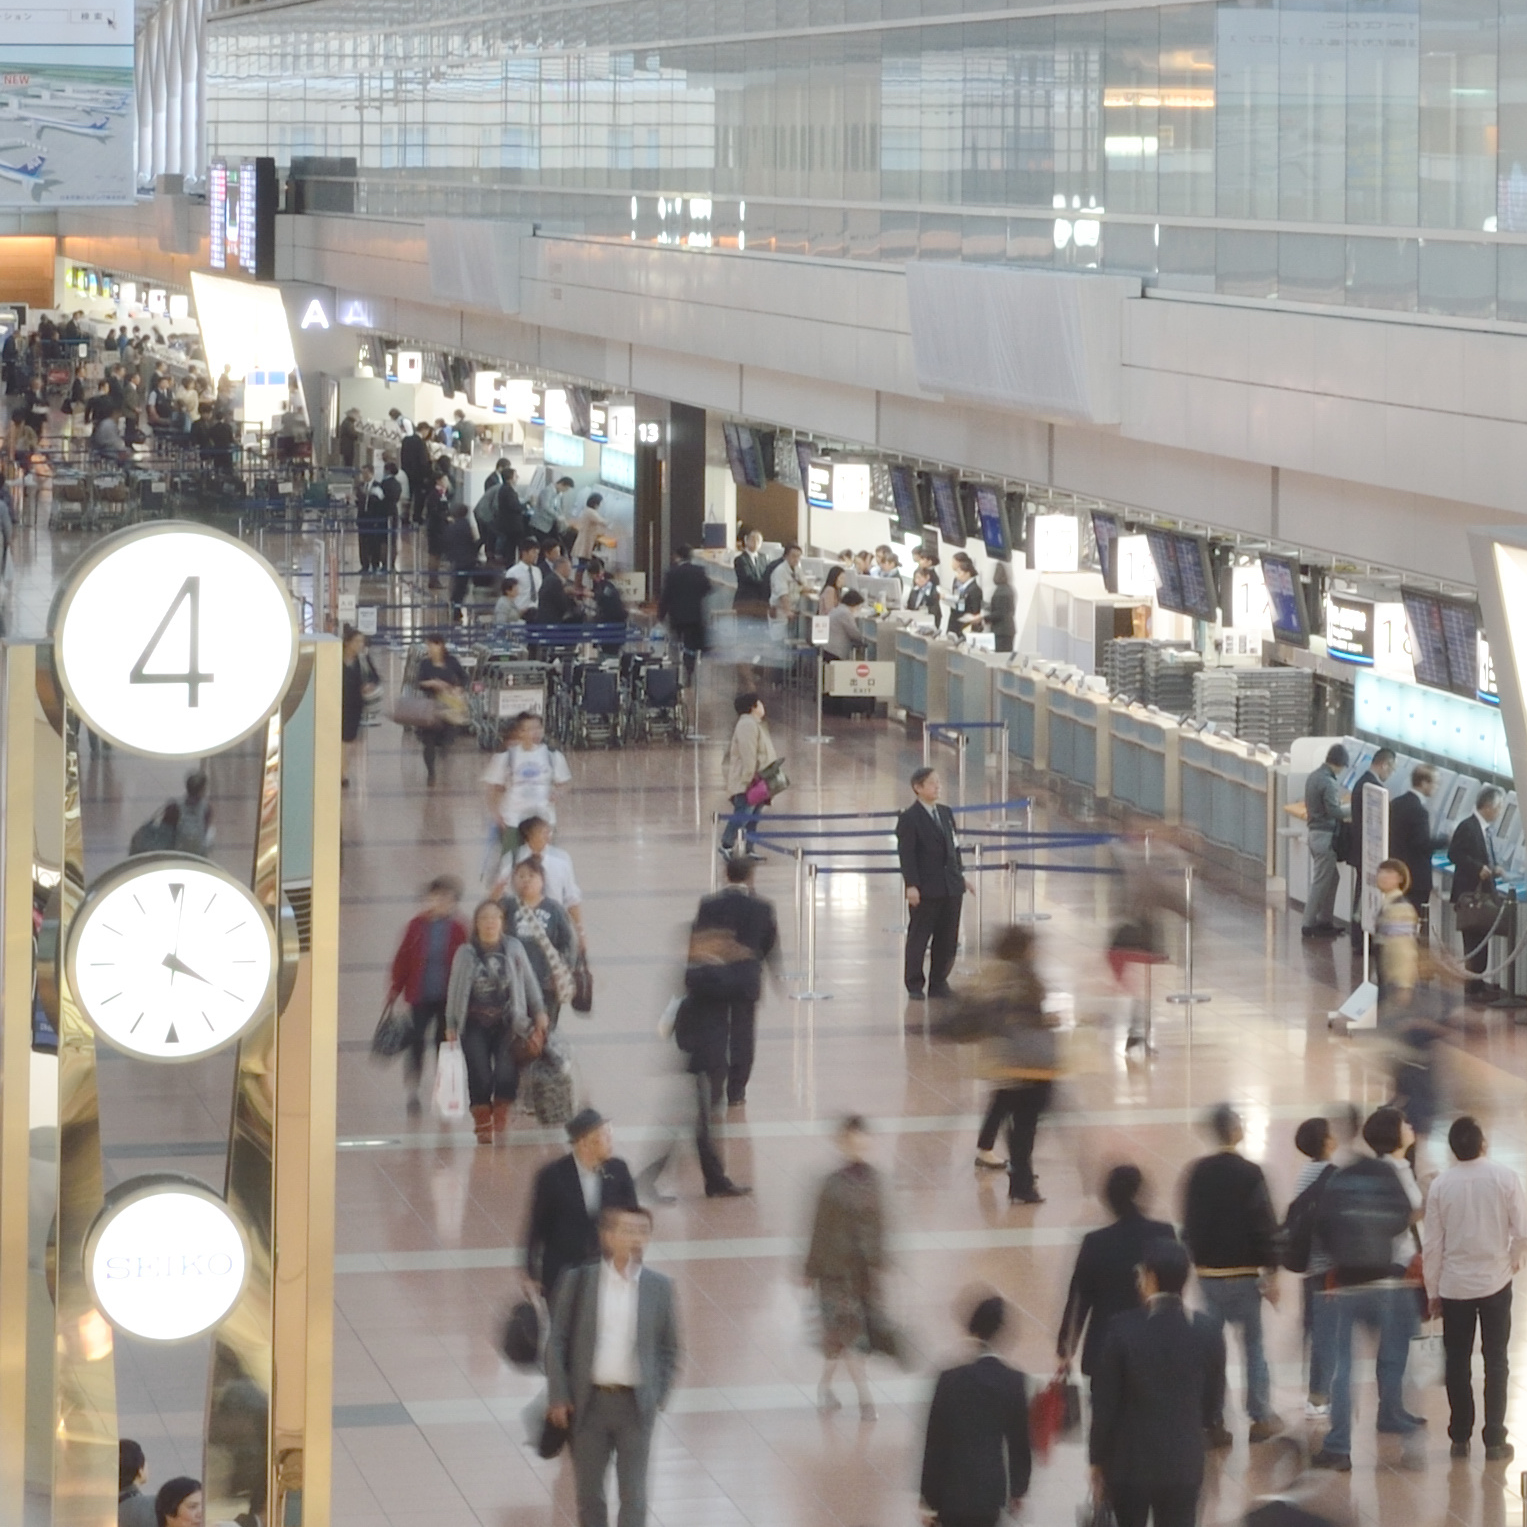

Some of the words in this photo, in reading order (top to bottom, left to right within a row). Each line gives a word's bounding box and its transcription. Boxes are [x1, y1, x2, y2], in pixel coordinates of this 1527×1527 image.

[4, 75, 30, 85] NEW
[301, 299, 330, 329] A
[638, 423, 659, 443] 13
[128, 575, 215, 708] 4
[849, 677, 876, 687] 出口
[105, 1251, 234, 1281] SEIKO
